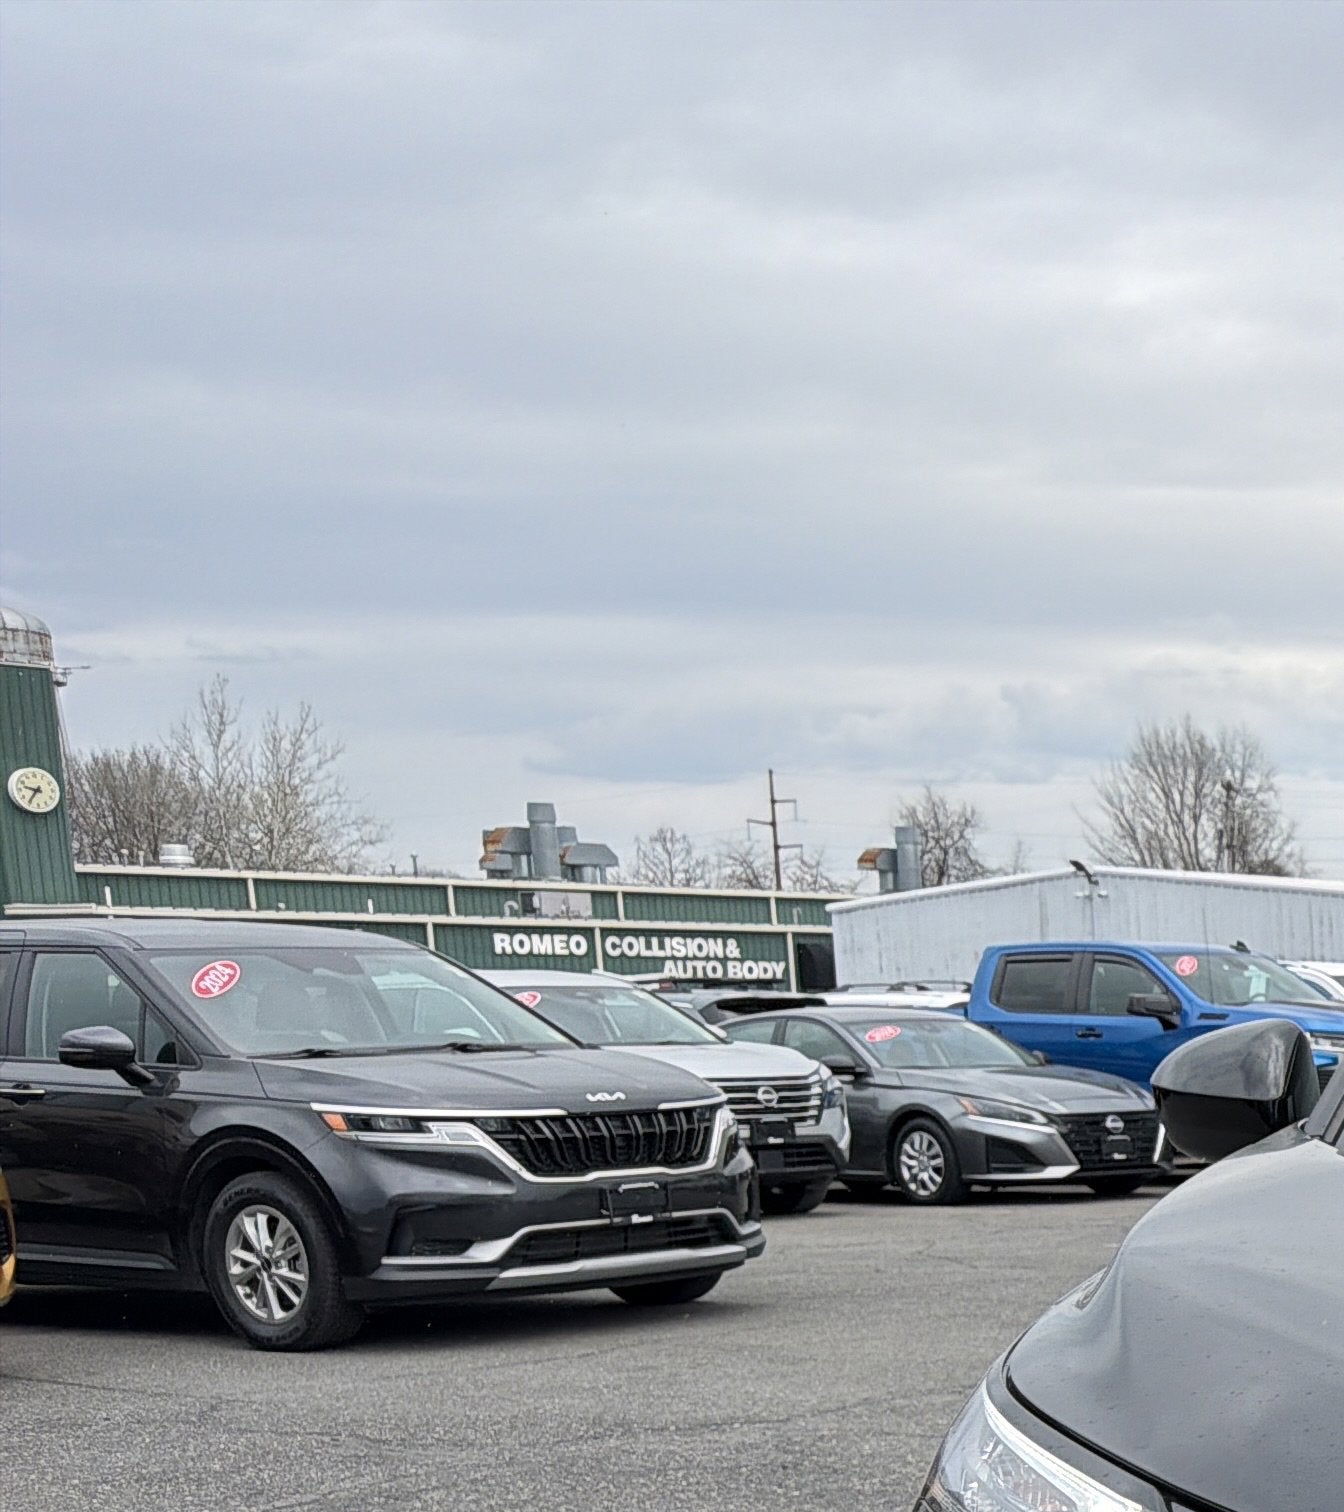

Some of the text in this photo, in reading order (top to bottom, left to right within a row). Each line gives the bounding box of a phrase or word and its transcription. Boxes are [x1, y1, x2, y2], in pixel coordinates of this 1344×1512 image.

[493, 932, 588, 956] ROMEO
[663, 959, 786, 980] AUTO BODY
